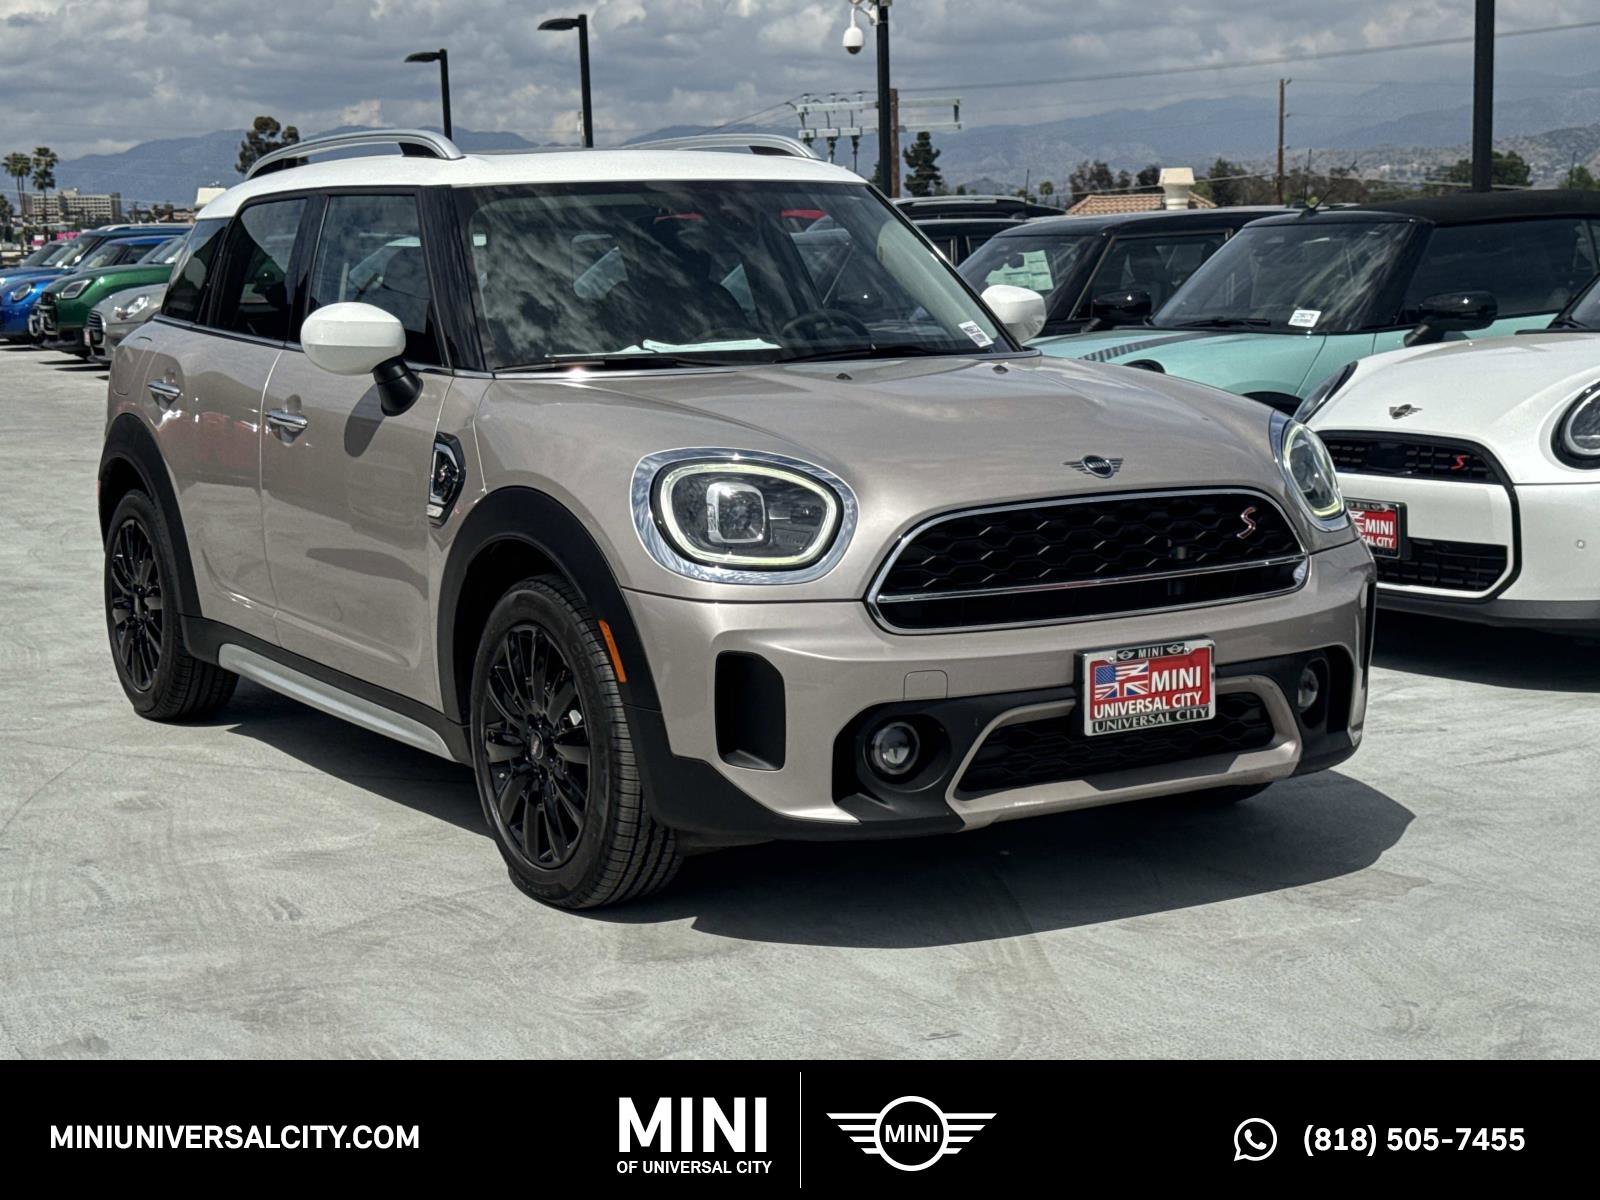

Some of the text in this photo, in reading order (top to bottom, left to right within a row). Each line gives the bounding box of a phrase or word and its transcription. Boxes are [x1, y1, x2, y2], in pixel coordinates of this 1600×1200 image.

[1237, 506, 1257, 539] S
[1365, 518, 1393, 536] MINI
[1376, 535, 1394, 548] CITY
[1138, 646, 1164, 659] MINI
[1151, 666, 1201, 693] MINI
[1094, 691, 1203, 719] UNIVERSAL CITY
[1095, 707, 1209, 733] UNIVERSAL CITY
